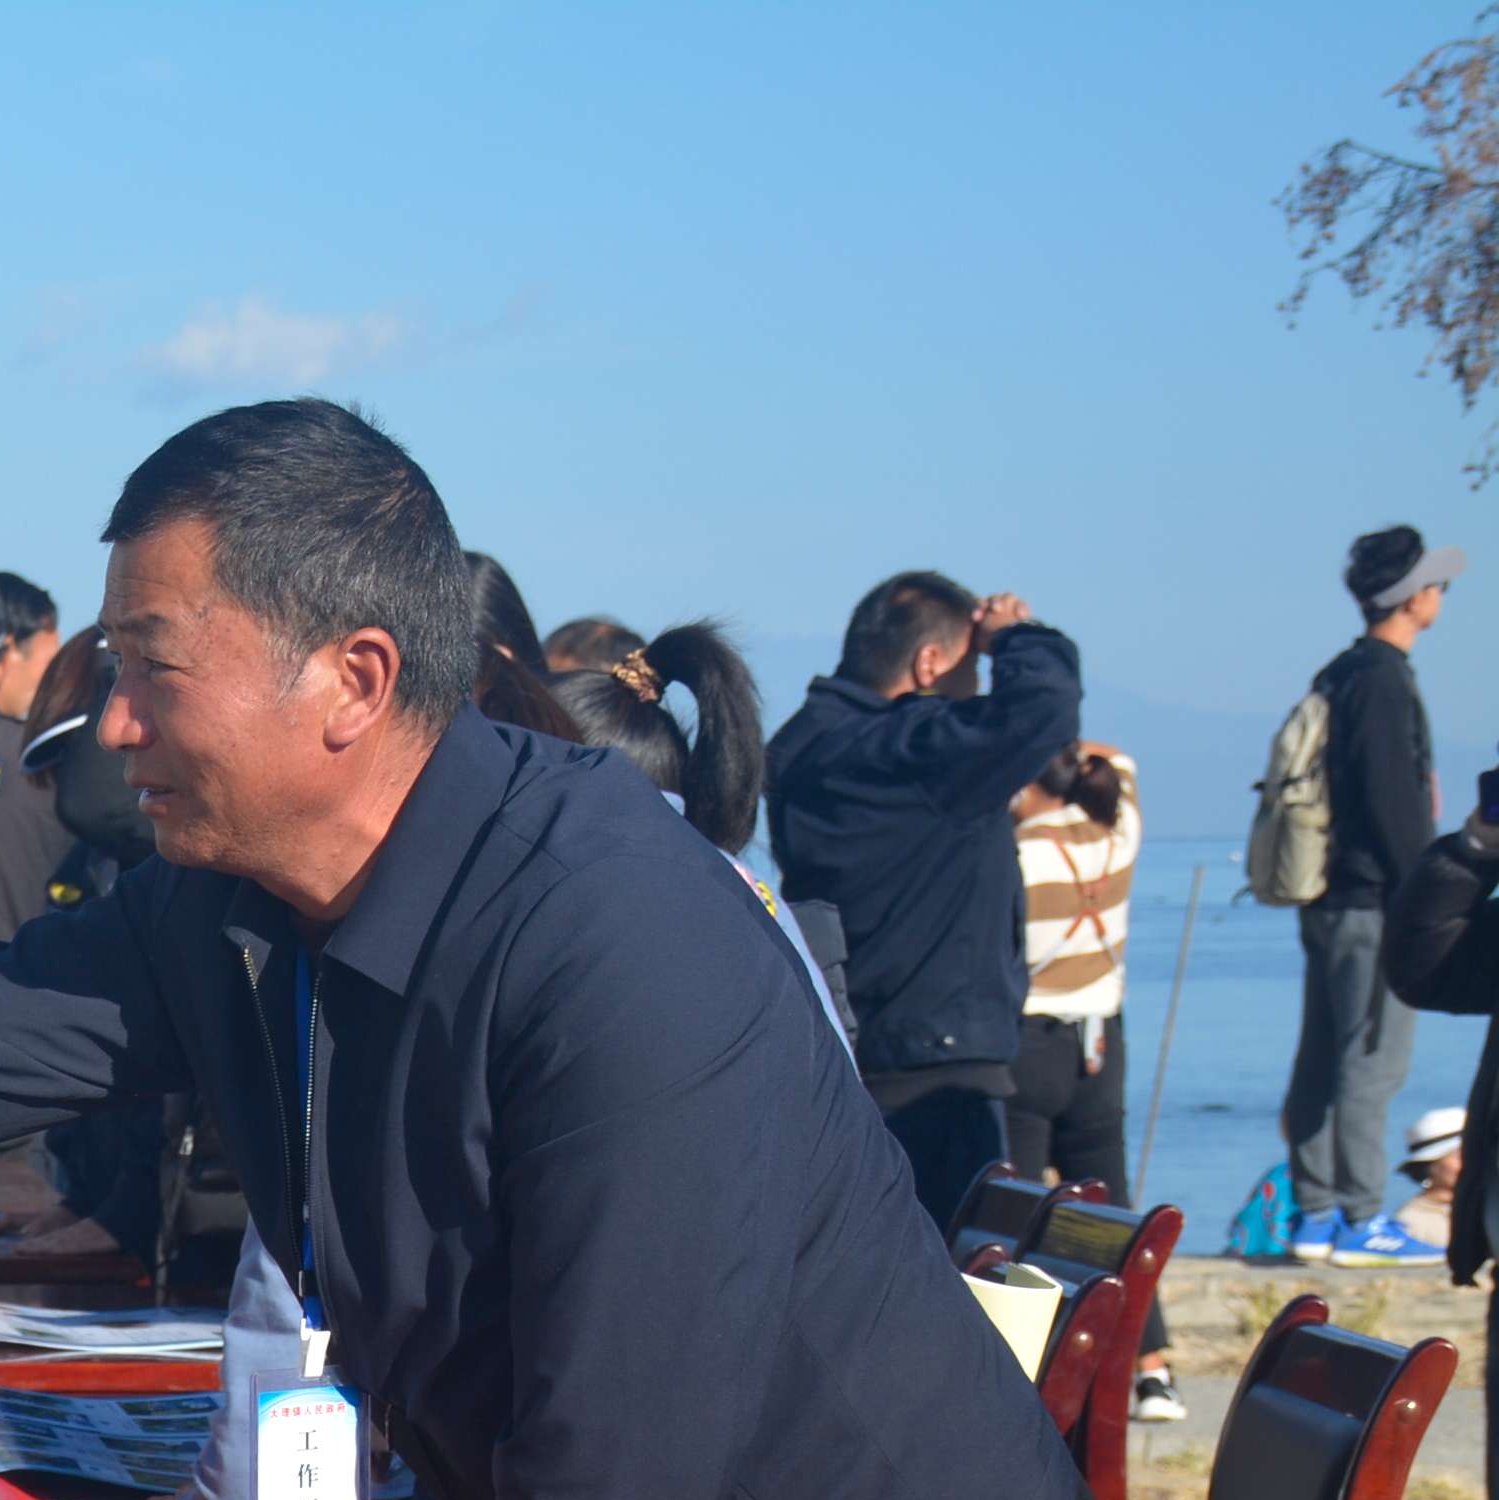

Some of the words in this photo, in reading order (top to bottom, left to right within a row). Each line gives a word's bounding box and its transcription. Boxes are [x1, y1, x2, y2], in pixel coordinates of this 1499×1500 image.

[269, 1402, 347, 1418] 大理镇人民政府
